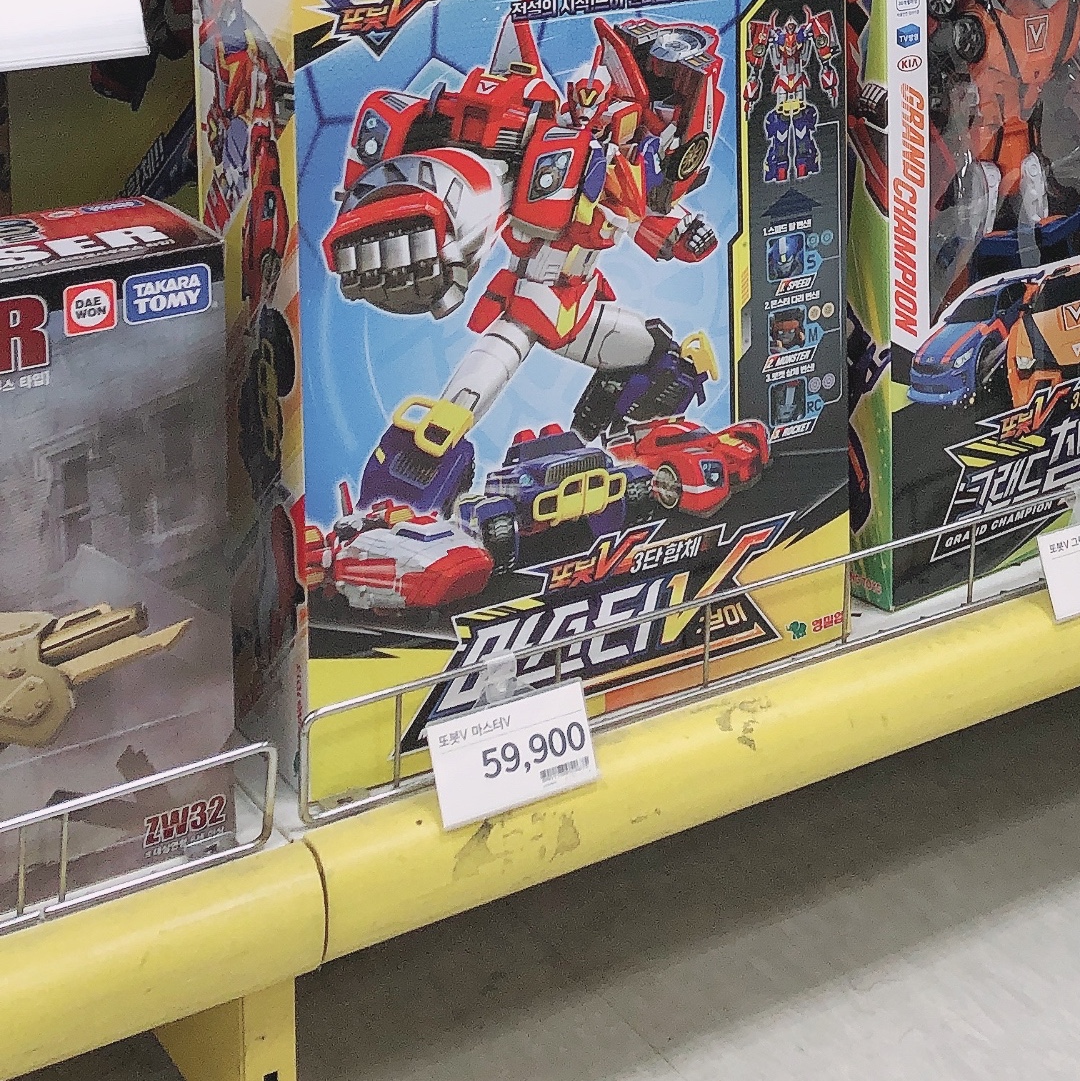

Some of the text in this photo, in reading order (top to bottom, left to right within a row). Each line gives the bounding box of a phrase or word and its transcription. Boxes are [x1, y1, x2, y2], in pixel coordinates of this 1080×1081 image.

[511, 0, 557, 19] 전설의
[901, 58, 919, 69] KIA
[892, 82, 926, 337] GRAND CHAMPION
[133, 274, 202, 296] TAKARA
[75, 295, 102, 309] DAE
[76, 306, 107, 320] WON
[133, 287, 202, 315] TOMY
[806, 397, 822, 414] RC
[989, 499, 1053, 532] CHAMPION
[438, 715, 512, 750] 또봇V 마스터V
[482, 720, 587, 780] 59,900
[142, 794, 228, 849] ZW32
